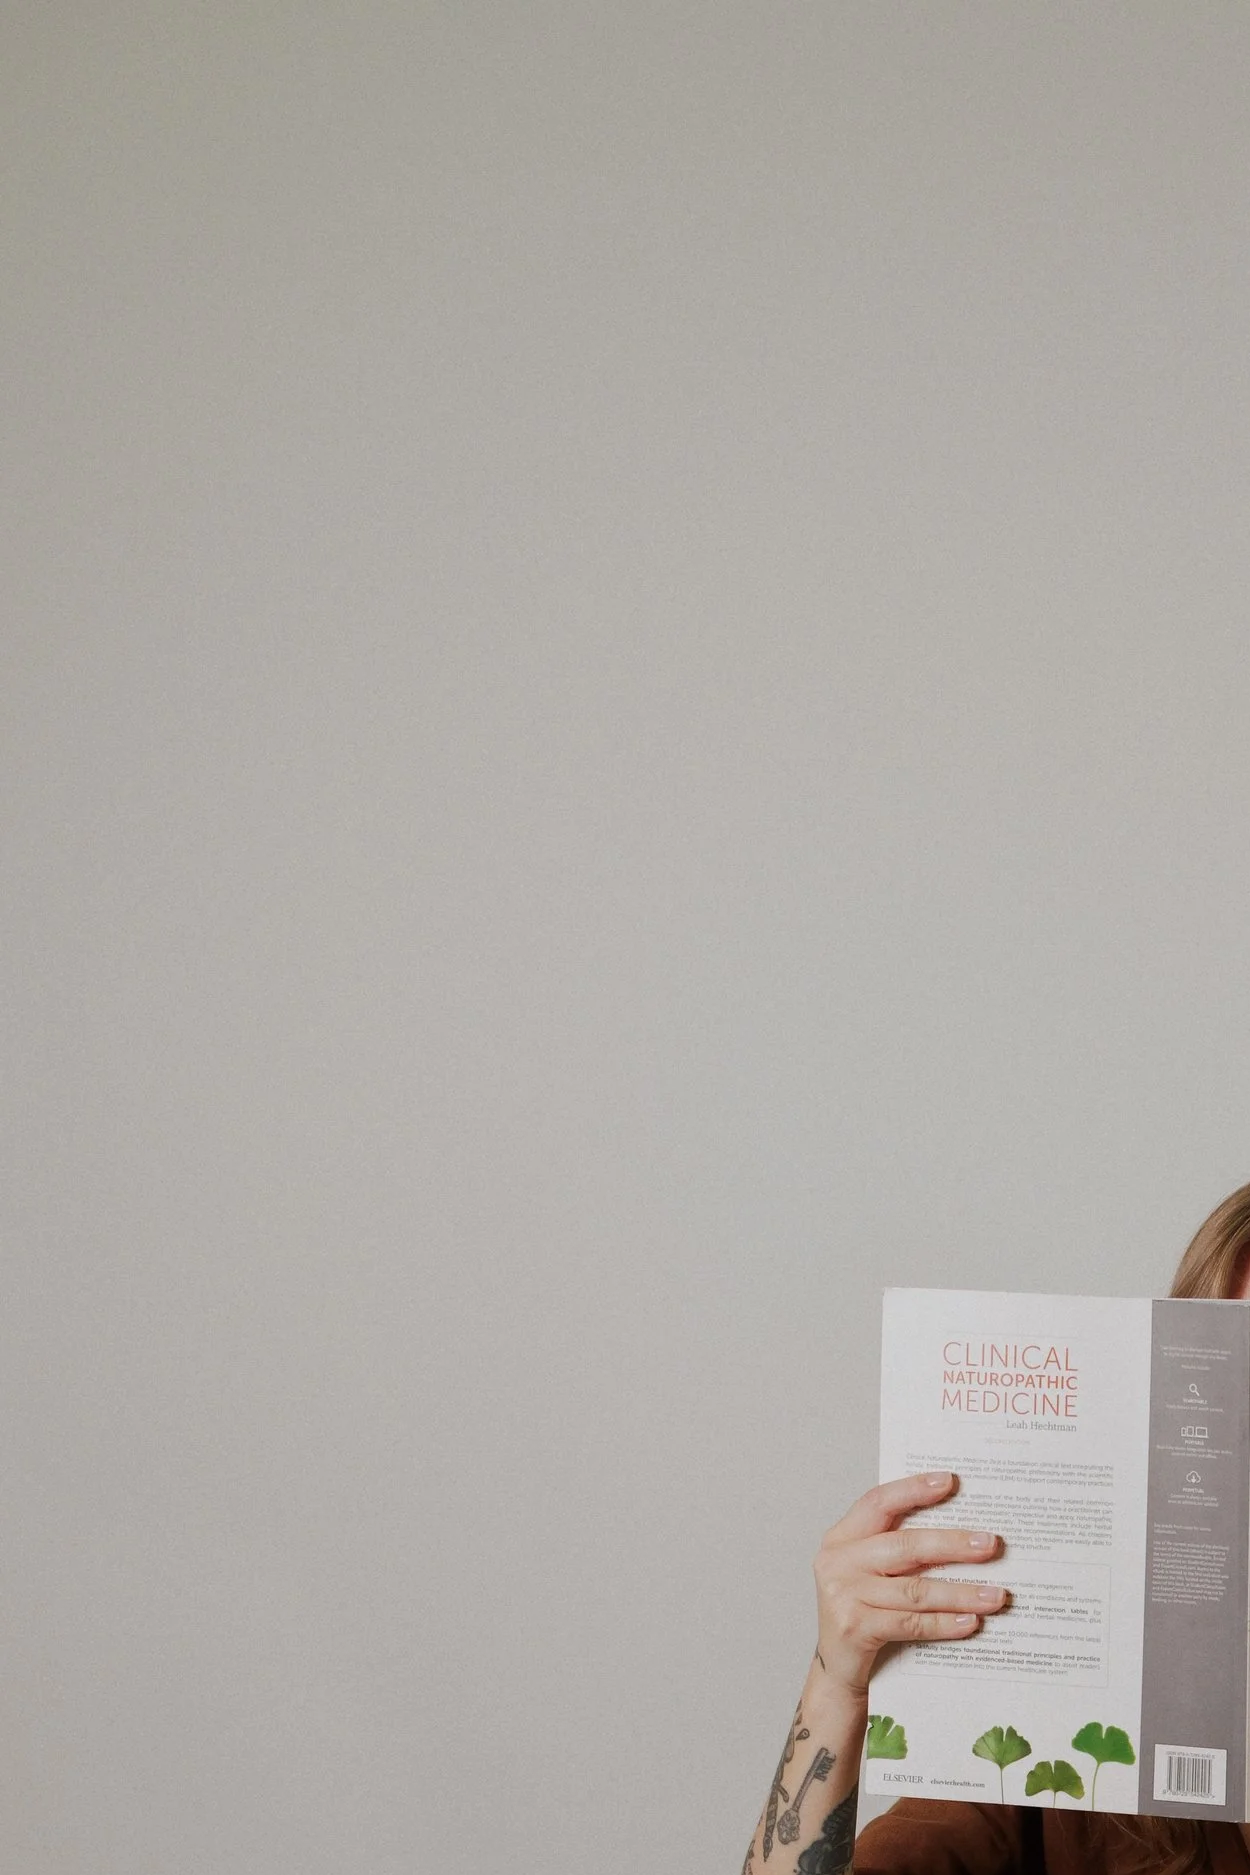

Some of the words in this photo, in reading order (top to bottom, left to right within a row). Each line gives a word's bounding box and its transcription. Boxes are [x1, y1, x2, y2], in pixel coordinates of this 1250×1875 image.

[943, 1341, 1078, 1371] CLINICAL
[943, 1370, 1078, 1390] NATUROPATHIC
[941, 1388, 1078, 1418] MEDICINE
[1006, 1420, 1027, 1430] Leah
[1030, 1421, 1077, 1432] Hechtman
[883, 1773, 924, 1784] ELSEVIER
